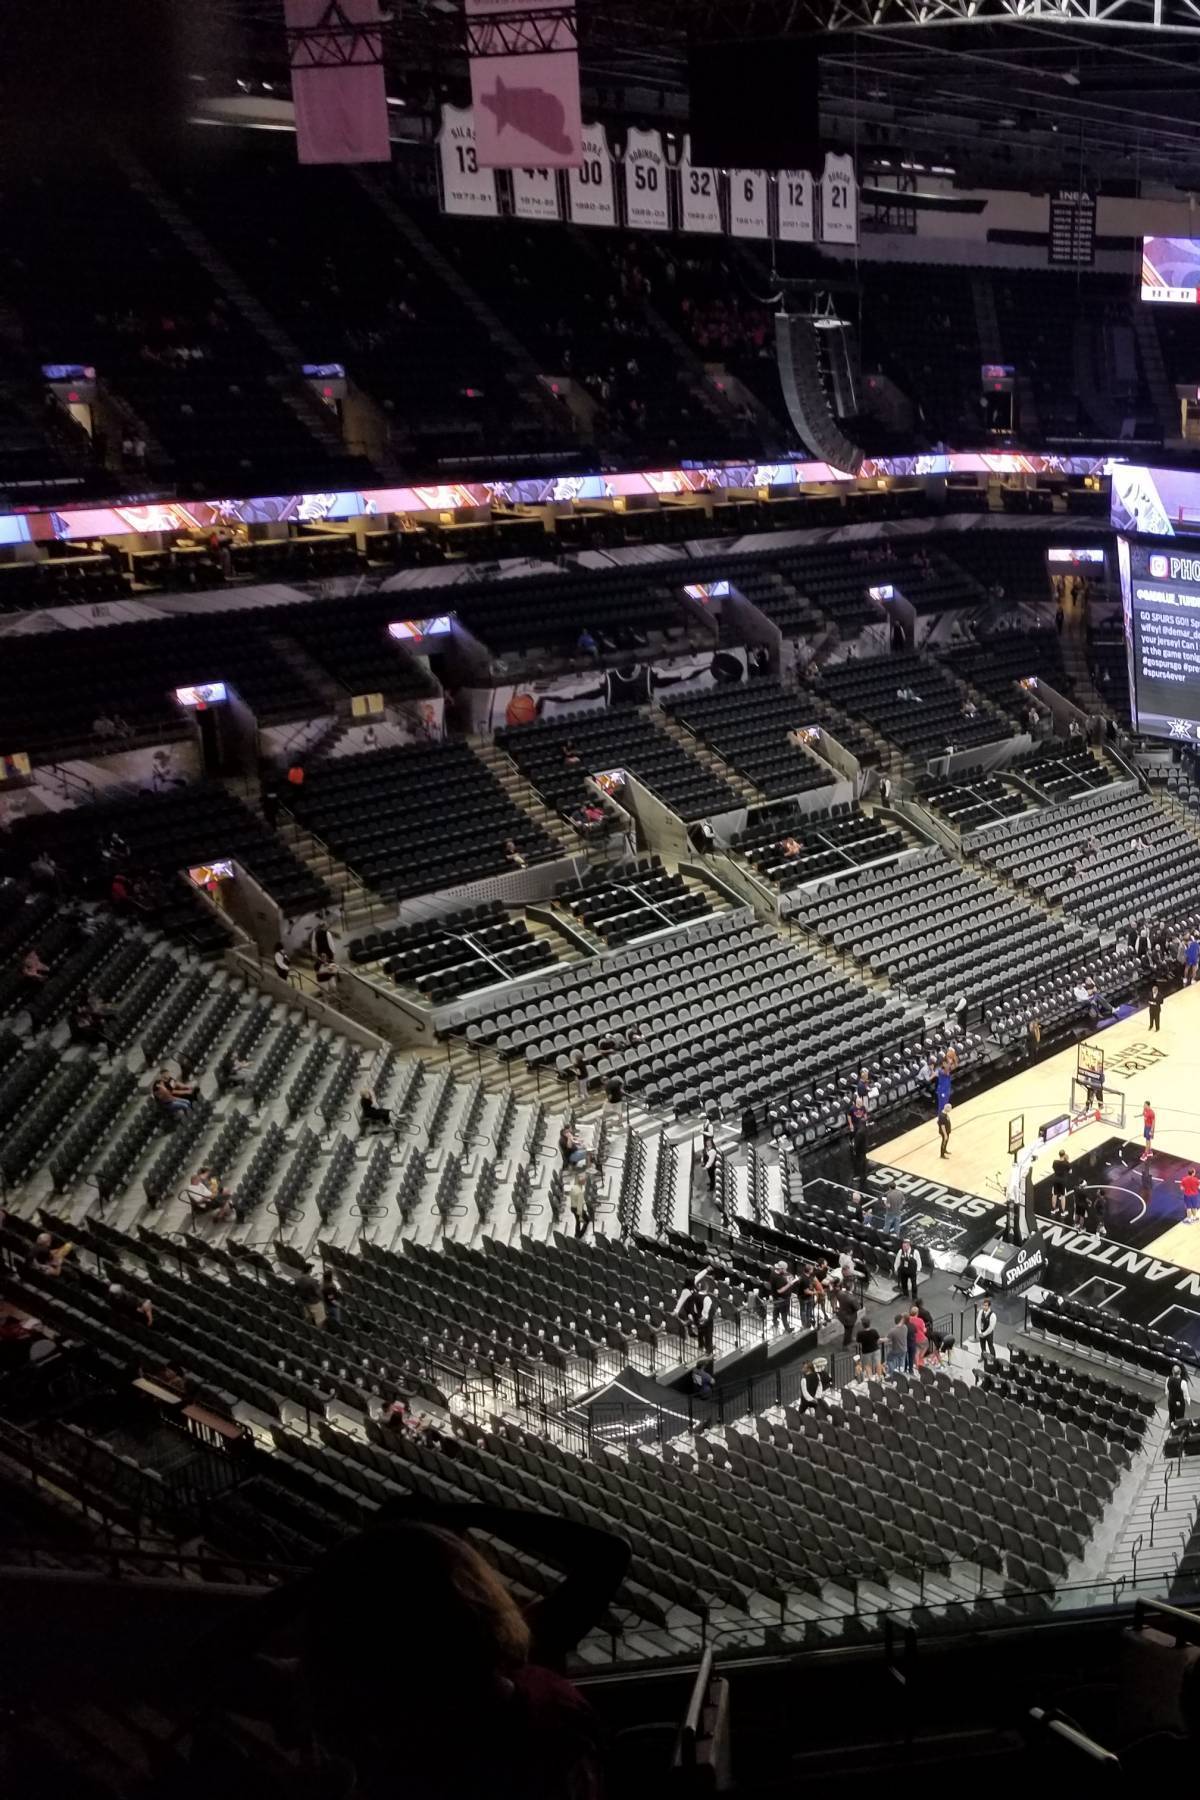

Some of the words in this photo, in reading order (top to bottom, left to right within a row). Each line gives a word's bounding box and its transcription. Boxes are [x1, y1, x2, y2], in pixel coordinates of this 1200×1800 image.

[456, 145, 479, 174] 13
[635, 164, 658, 191] 50
[690, 170, 711, 197] 32
[743, 177, 754, 202] 6
[788, 182, 804, 207] 12
[831, 185, 847, 209] 21
[1140, 611, 1150, 620] GO
[1151, 612, 1175, 625] SPURS
[1140, 635, 1157, 645] your
[1181, 640, 1195, 651] Can
[1141, 645, 1150, 655] at
[1150, 646, 1162, 656] the
[1162, 649, 1182, 659] game
[1142, 656, 1182, 671] #gospursgo
[1111, 1046, 1169, 1080] AT&T
[866, 1166, 996, 1218] SPURS
[1005, 1249, 1042, 1286] SPALDING
